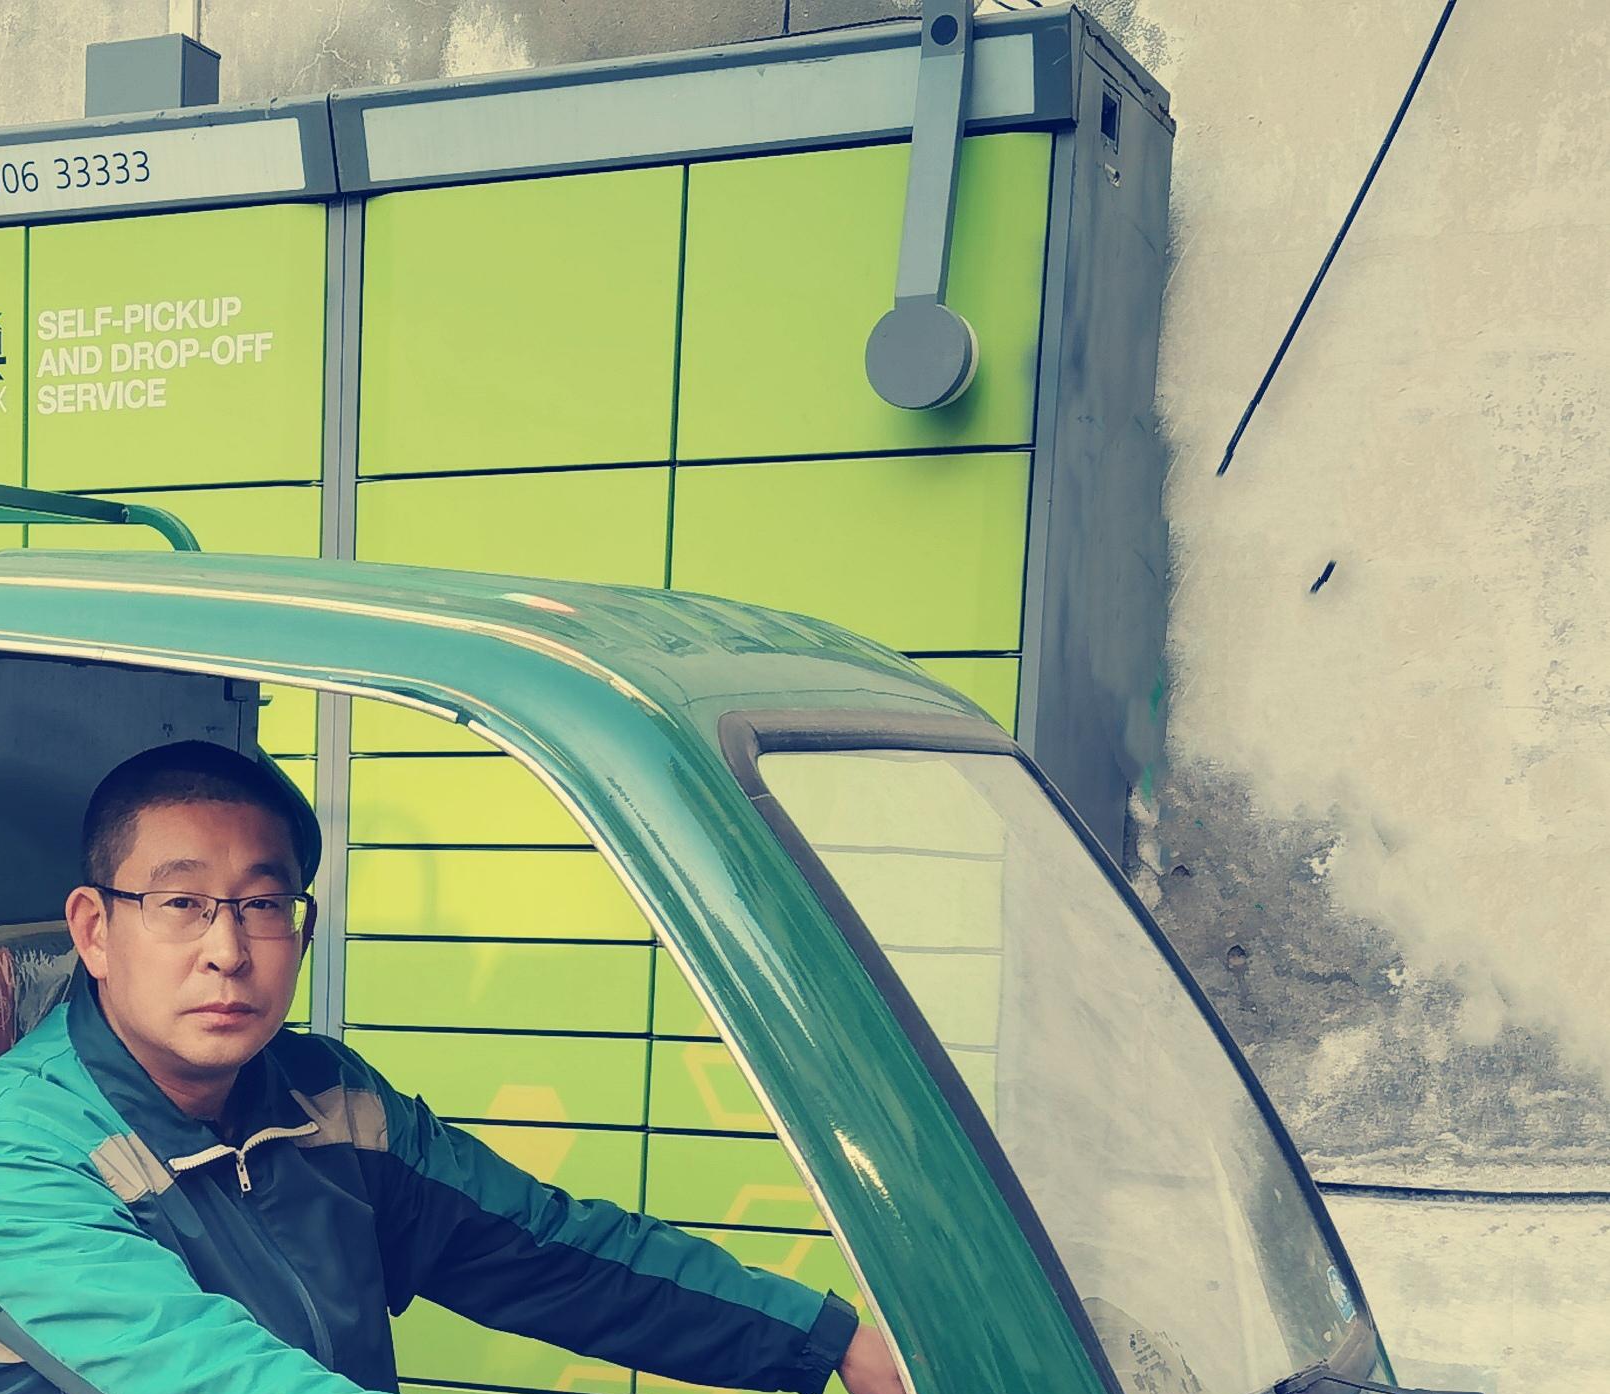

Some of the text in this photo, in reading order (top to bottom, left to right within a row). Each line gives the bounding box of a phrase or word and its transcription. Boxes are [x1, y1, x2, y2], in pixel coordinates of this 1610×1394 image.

[54, 151, 150, 189] 33333
[37, 296, 242, 341] SELF-PICKUP
[36, 332, 274, 378] AND DROP-OFF
[37, 378, 167, 415] SERVICE
